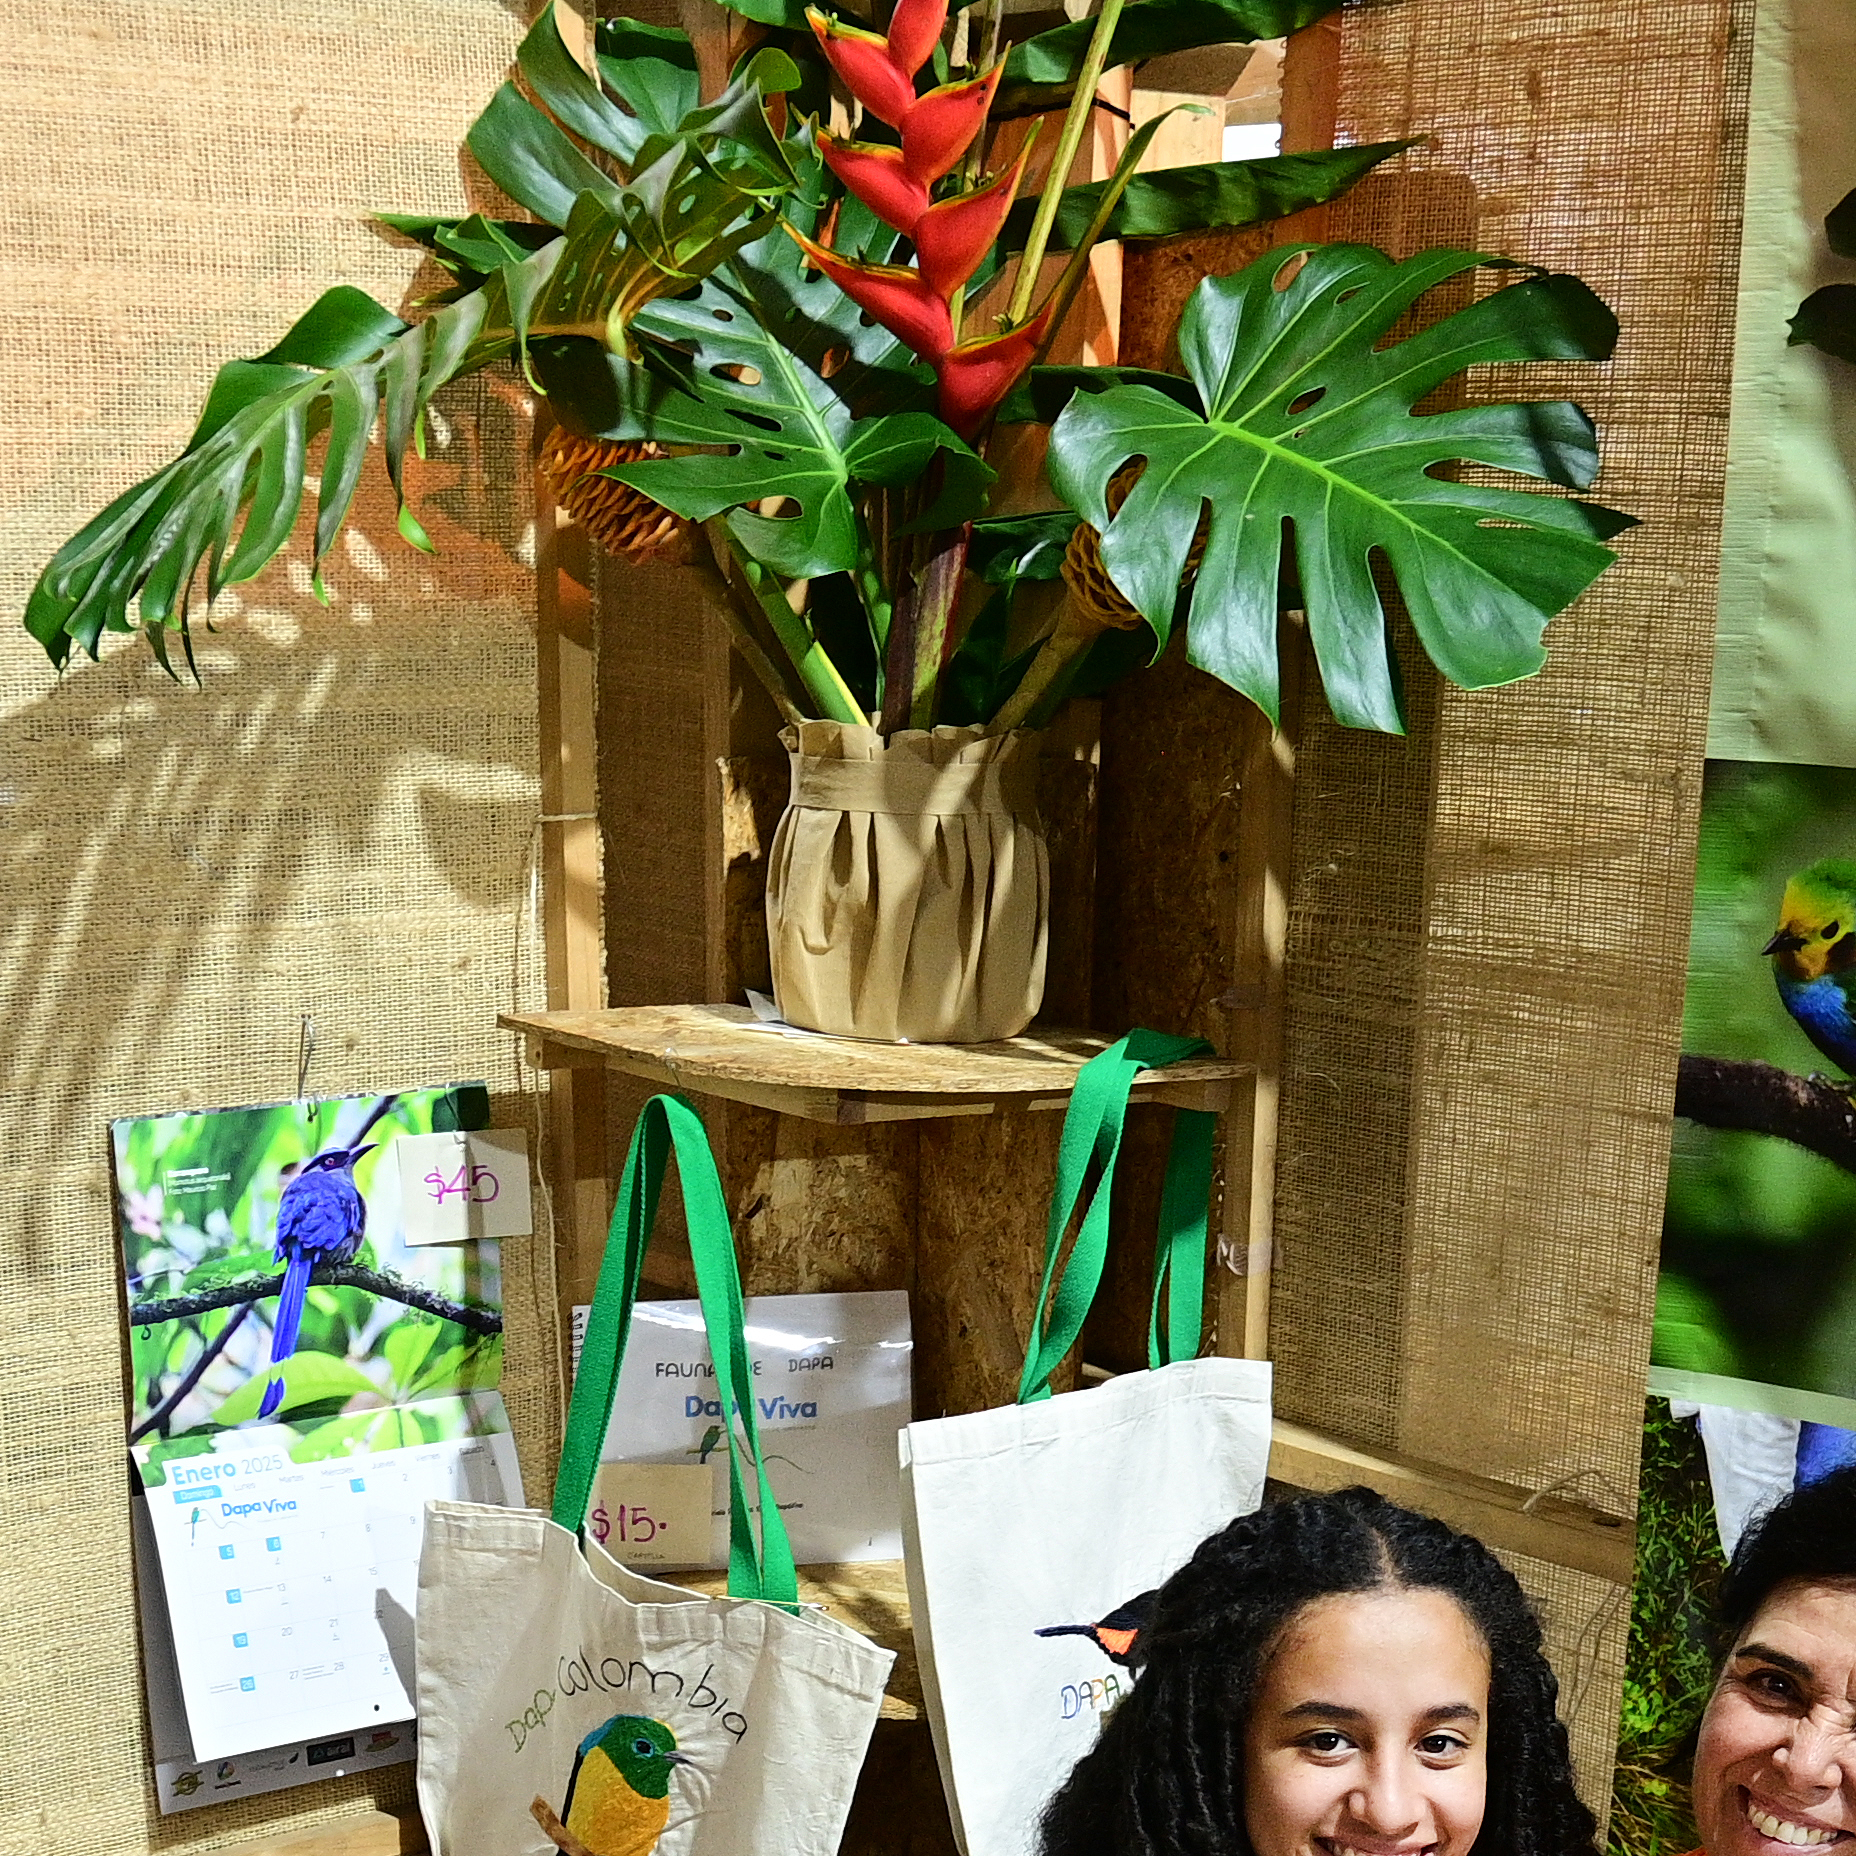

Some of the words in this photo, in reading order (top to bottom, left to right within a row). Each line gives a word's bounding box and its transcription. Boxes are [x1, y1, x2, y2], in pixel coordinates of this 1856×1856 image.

[424, 1165, 499, 1204] $45
[788, 1356, 834, 1373] DAPA
[759, 1396, 818, 1419] Viva
[172, 1462, 237, 1486] Enero
[241, 1454, 283, 1475] 2025
[221, 1501, 261, 1519] Dapa
[263, 1499, 297, 1515] Viva
[557, 1645, 748, 1744] Colombia
